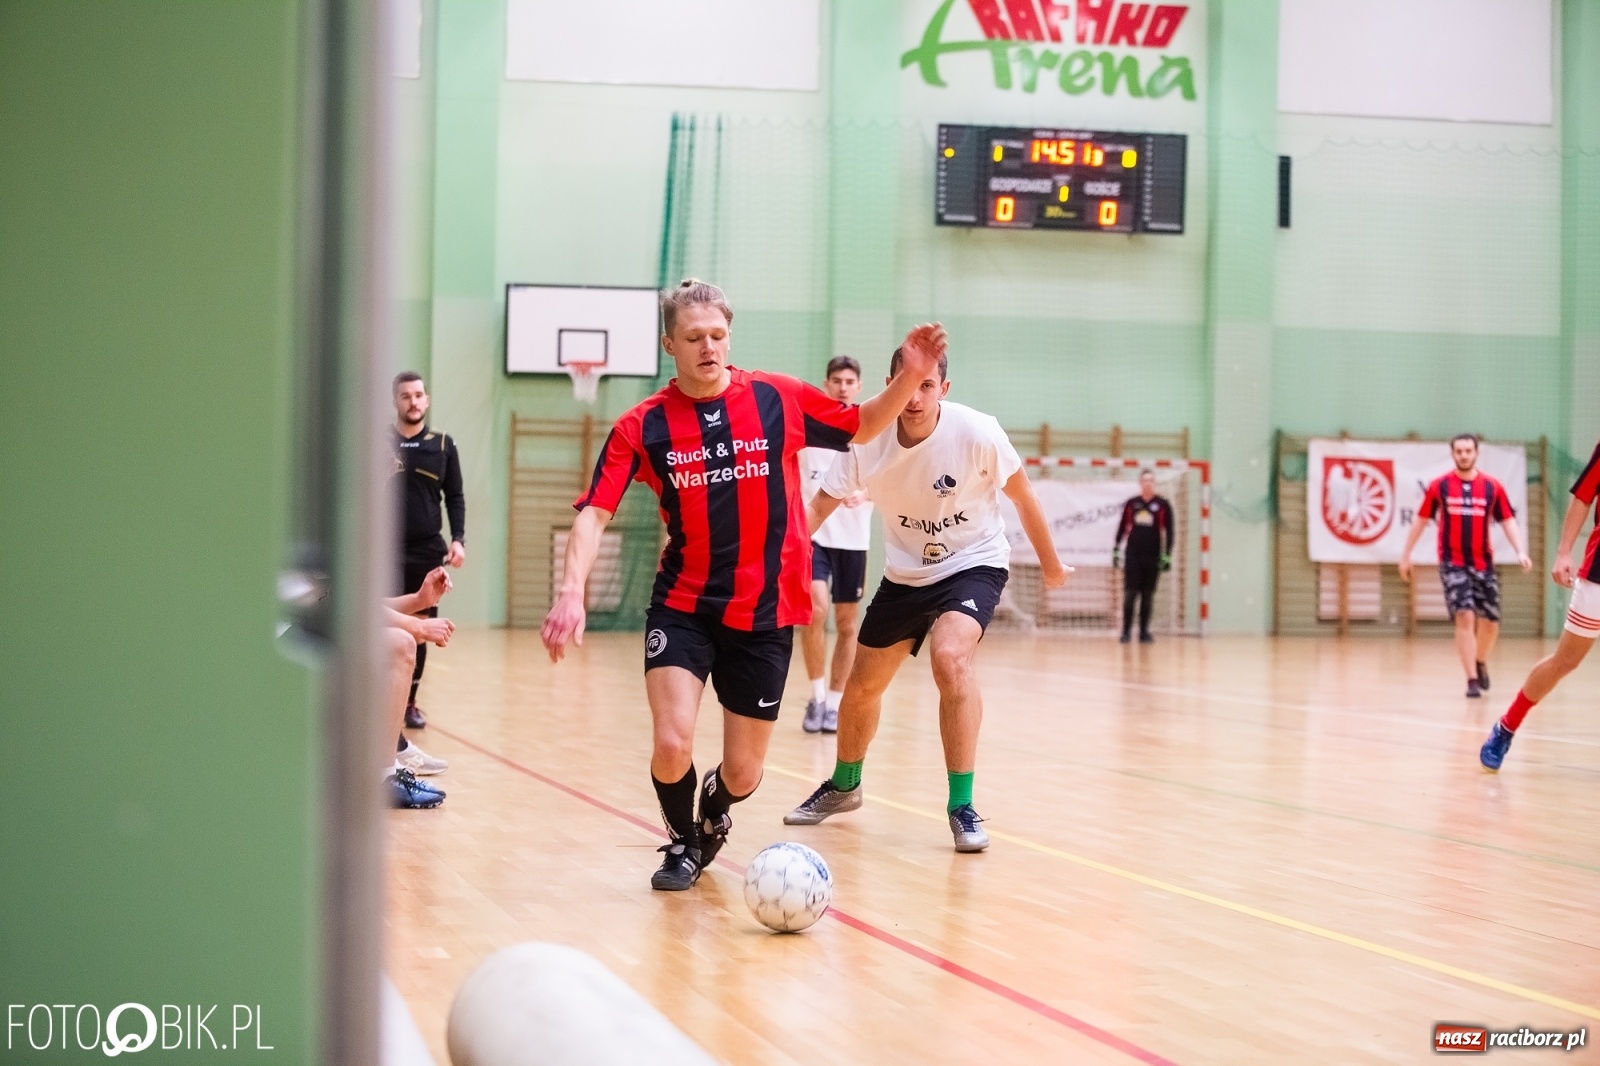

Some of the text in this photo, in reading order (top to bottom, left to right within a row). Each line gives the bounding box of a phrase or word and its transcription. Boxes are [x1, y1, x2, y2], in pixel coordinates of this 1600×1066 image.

[901, 0, 1197, 101] Arena
[666, 437, 769, 466] Stuck & Putz
[668, 460, 770, 489] Warzecha
